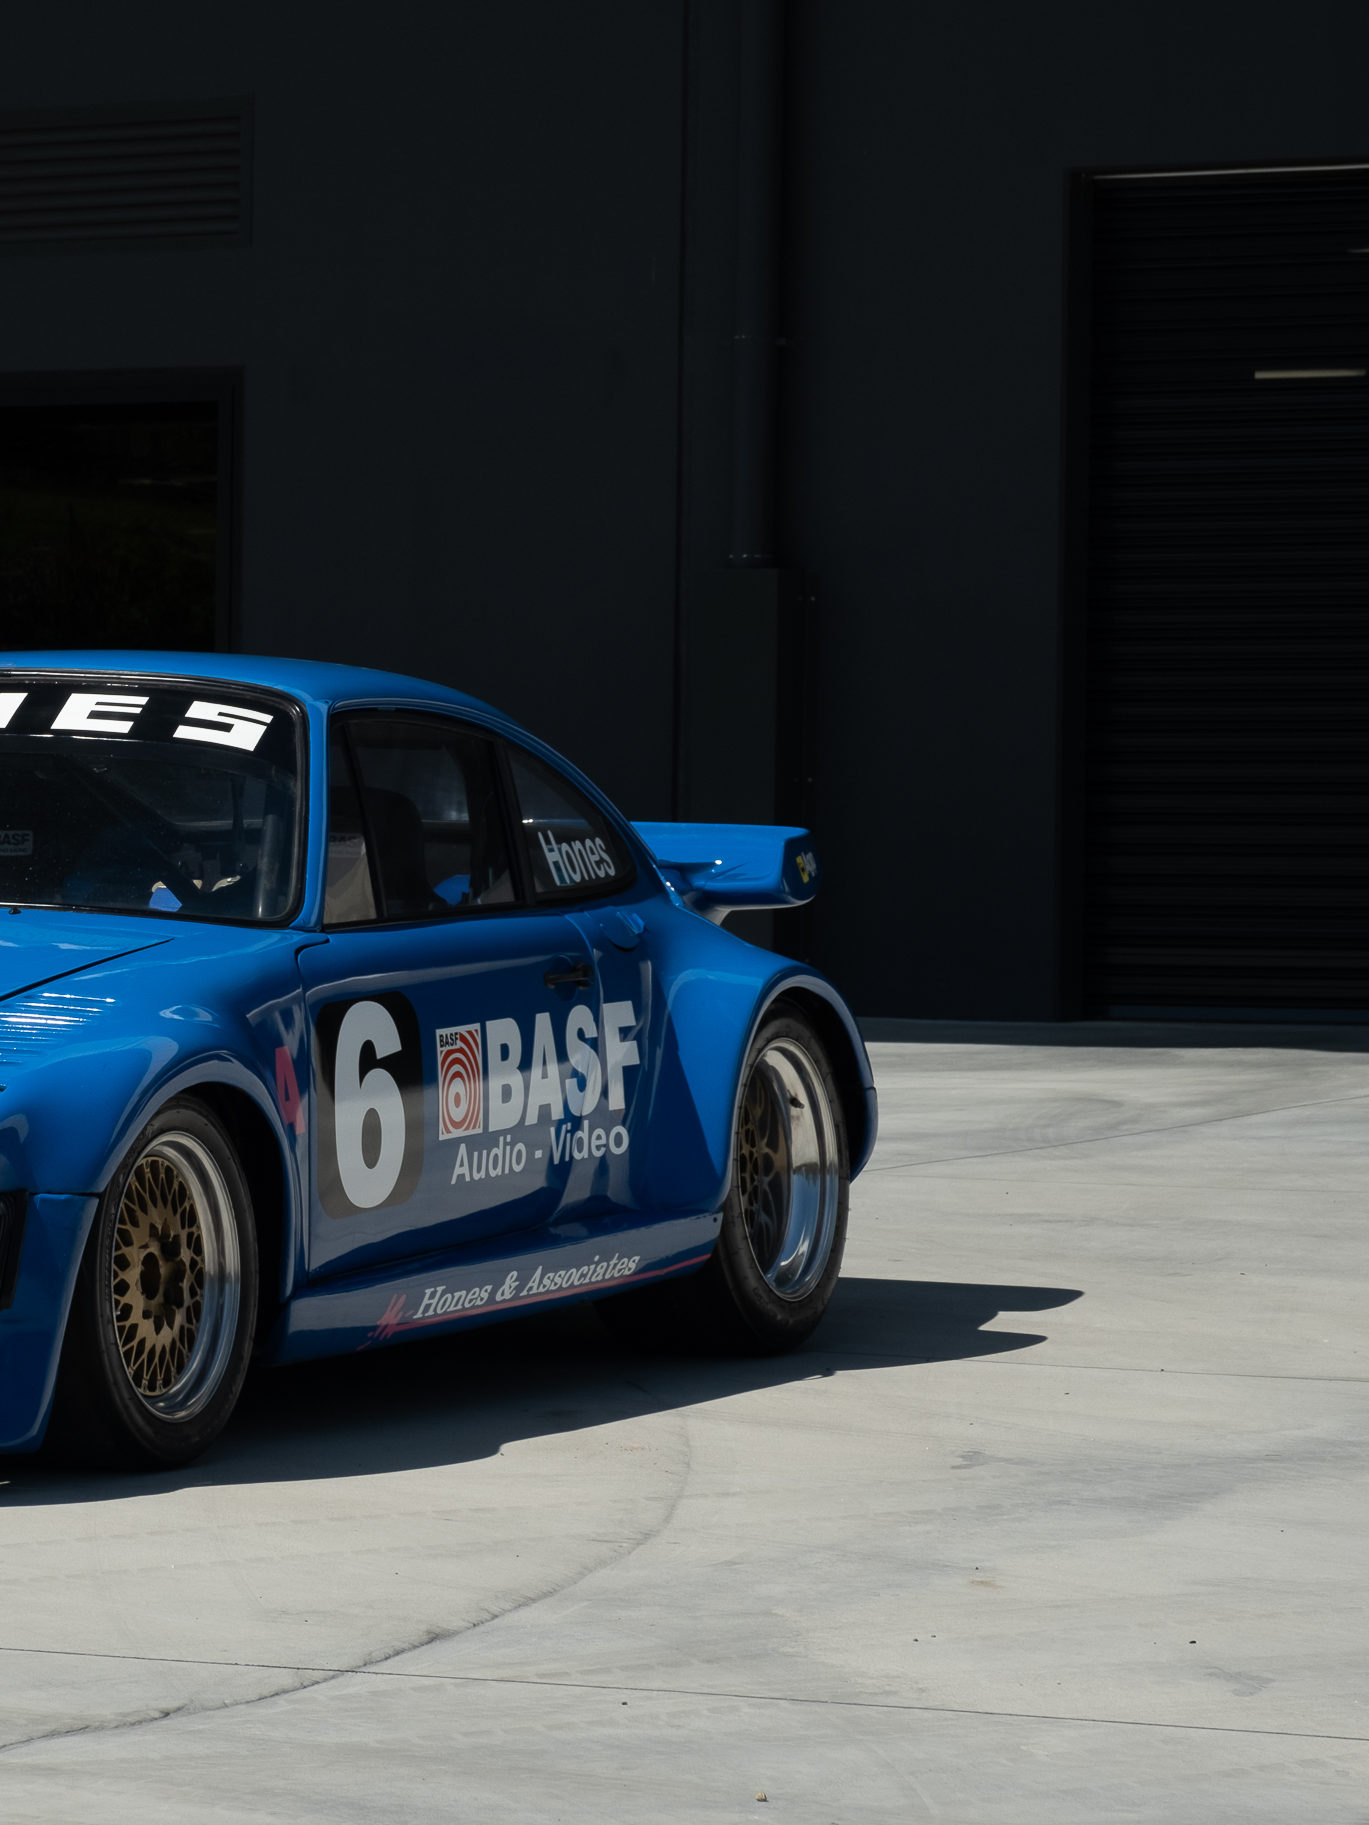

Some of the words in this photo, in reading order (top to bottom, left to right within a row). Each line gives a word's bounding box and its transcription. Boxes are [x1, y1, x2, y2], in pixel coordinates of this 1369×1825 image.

[537, 830, 616, 886] Hones
[438, 1032, 460, 1049] BASF
[485, 1001, 640, 1132] BASF
[334, 1001, 406, 1209] 6
[451, 1135, 527, 1185] Audio
[550, 1122, 630, 1165] Video
[413, 1285, 493, 1319] Hones
[495, 1271, 520, 1302] &
[519, 1252, 641, 1297] Associates
